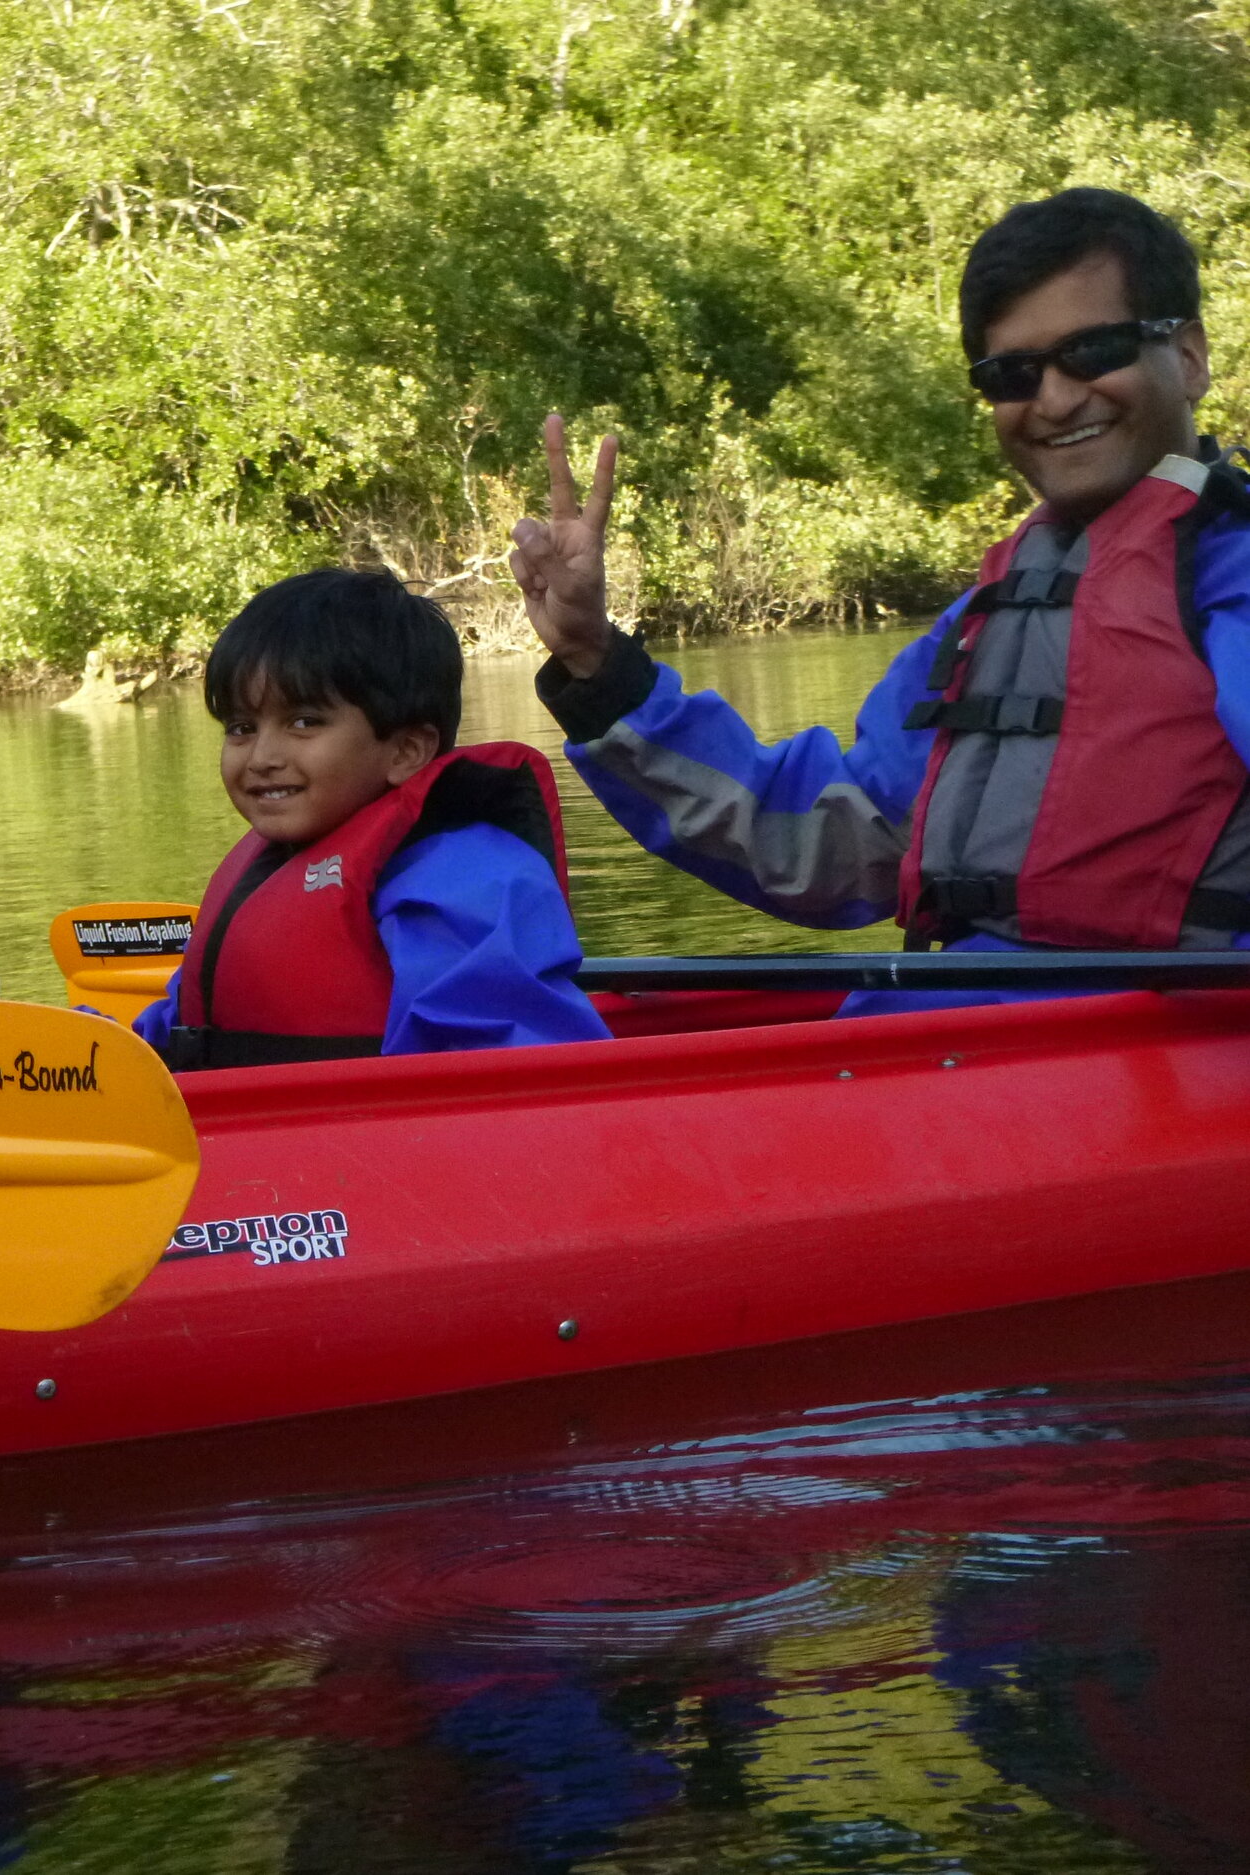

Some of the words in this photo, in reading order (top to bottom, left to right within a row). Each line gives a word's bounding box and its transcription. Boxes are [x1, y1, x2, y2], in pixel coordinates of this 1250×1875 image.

[74, 922, 107, 946] Liquid
[105, 921, 141, 943] Fusion
[140, 919, 192, 945] Kayaking
[250, 1232, 348, 1266] SPORT
